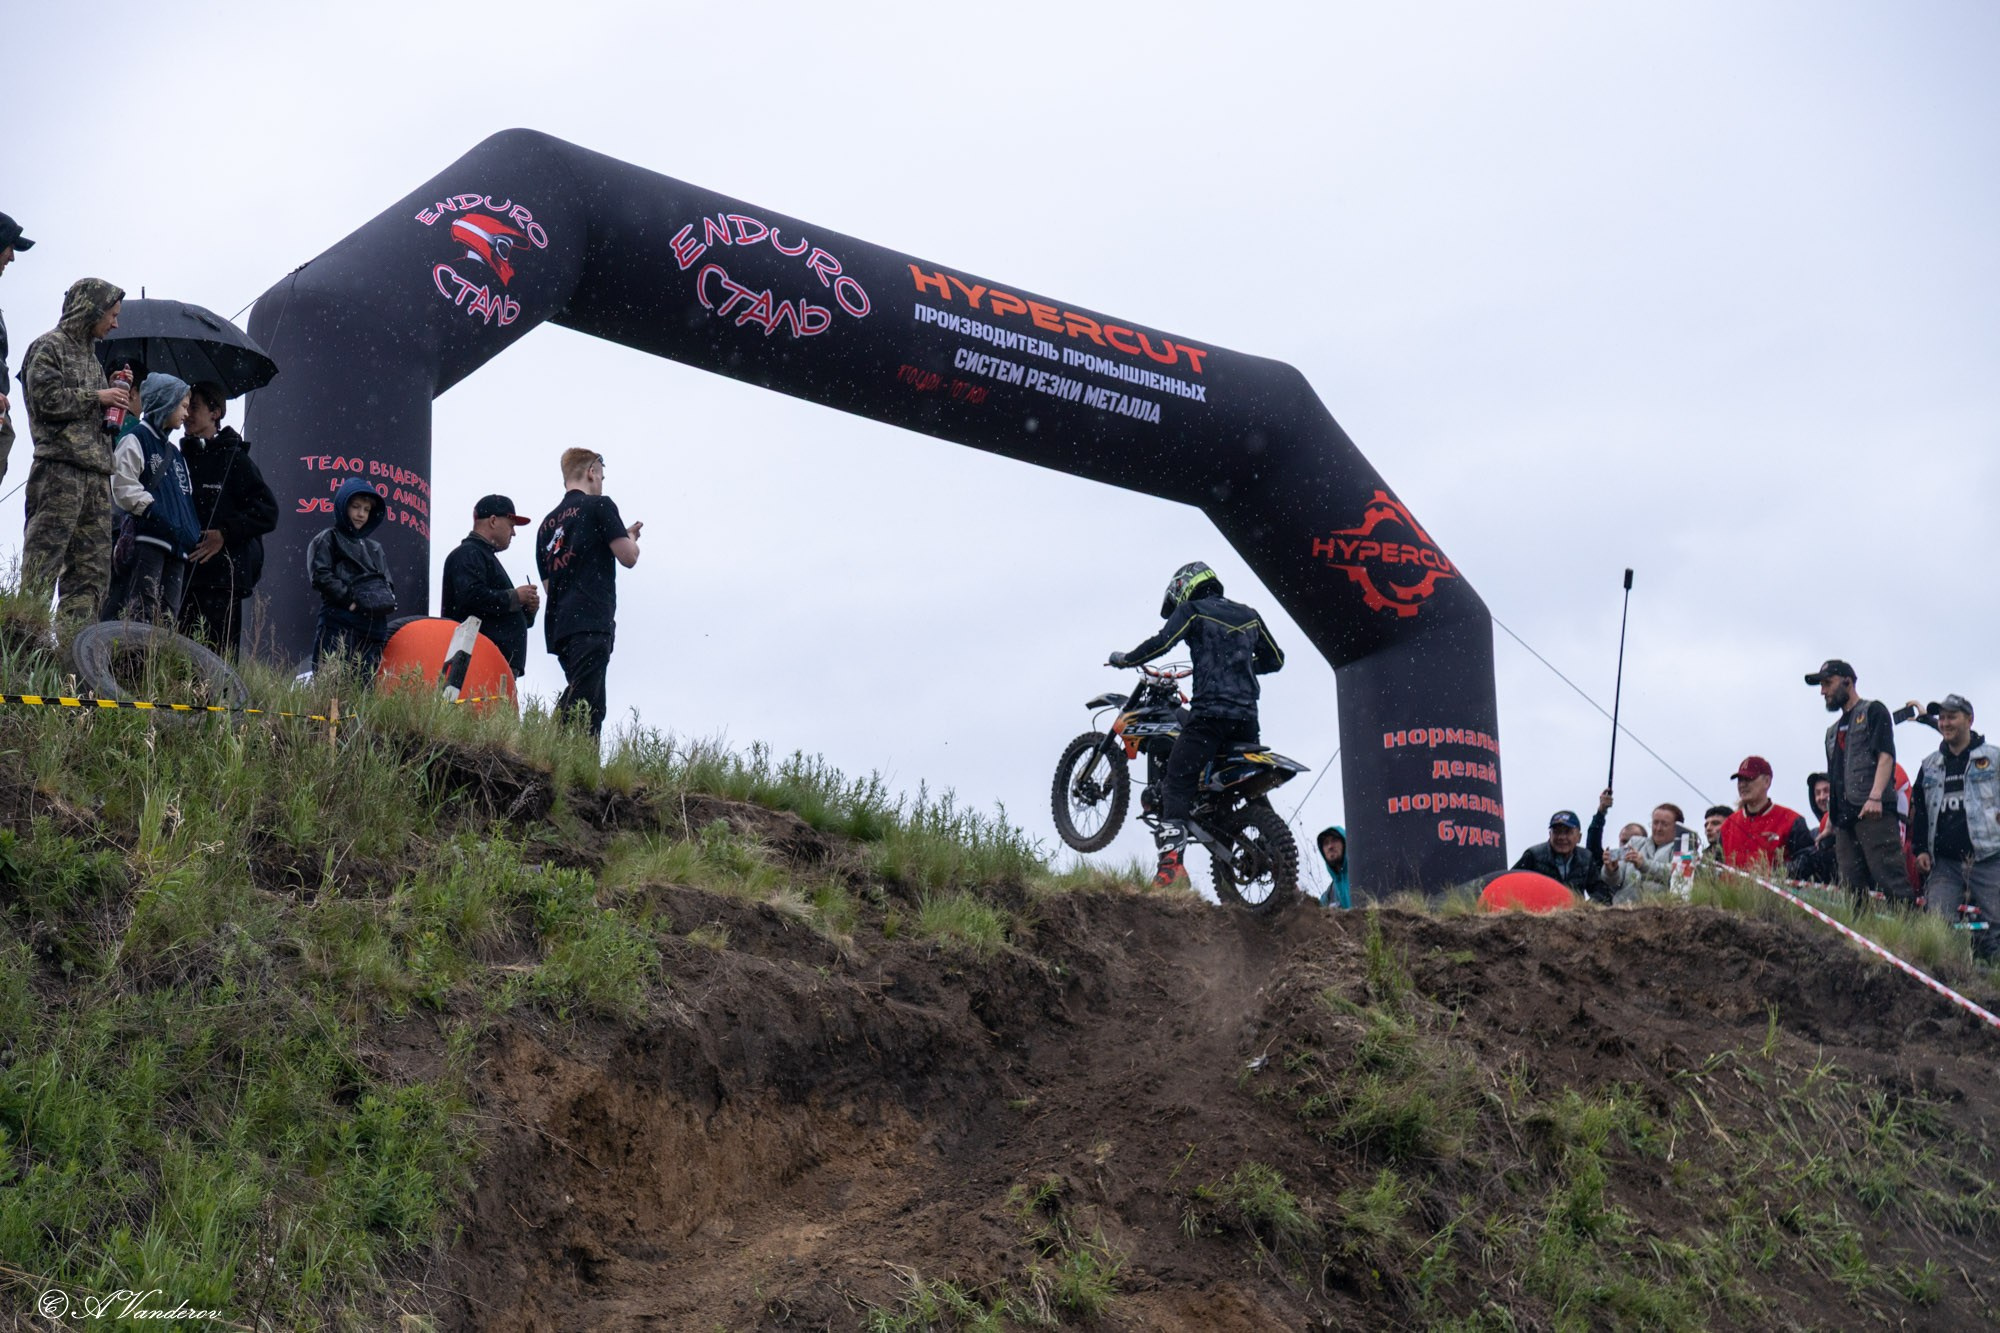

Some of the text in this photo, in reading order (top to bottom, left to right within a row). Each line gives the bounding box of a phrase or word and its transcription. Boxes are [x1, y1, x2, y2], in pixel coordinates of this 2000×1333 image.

[415, 193, 548, 249] ENDURO
[669, 212, 871, 318] ENDURO
[908, 263, 1208, 374] HYPERCUT
[913, 302, 1207, 403] ПРОИЗВОДИТЕЛЬ ПРОМЫШЛЕННЫХ
[953, 347, 1162, 425] СИСТЕМ РЕЗКИ МЕТАЛЛА
[300, 456, 364, 473] ТЕЛО
[1432, 760, 1498, 784] делай
[1438, 820, 1501, 848] будет
